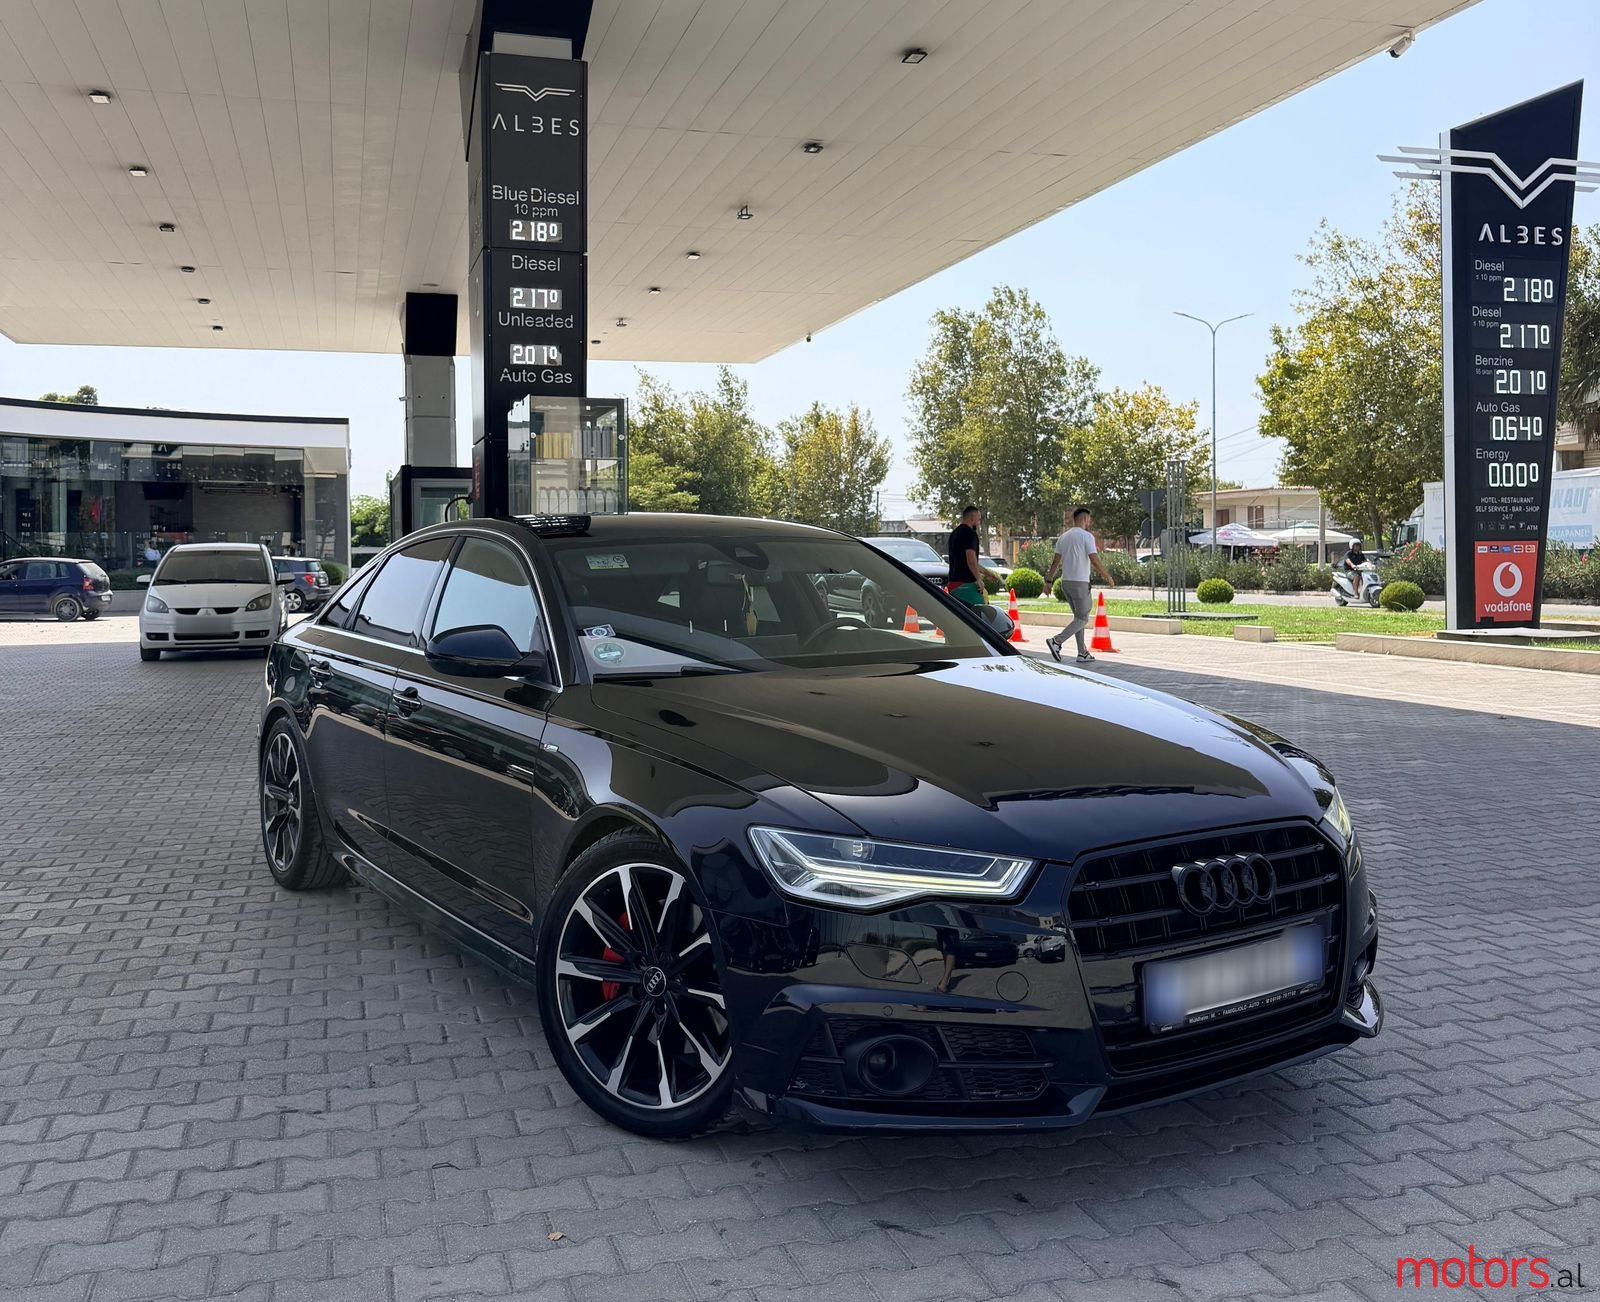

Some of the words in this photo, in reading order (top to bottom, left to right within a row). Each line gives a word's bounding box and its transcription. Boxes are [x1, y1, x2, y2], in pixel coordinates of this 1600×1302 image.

[492, 184, 528, 201] Blue
[530, 187, 580, 205] Diesel
[514, 203, 528, 215] 10
[532, 206, 558, 218] ppm
[511, 255, 561, 272] Diesel
[1474, 259, 1505, 272] Diesel
[1472, 305, 1502, 318] Diesel
[498, 312, 574, 329] Unleaded
[1475, 354, 1514, 367] Benzine
[500, 368, 537, 383] Auto
[541, 369, 573, 384] Gas
[1475, 401, 1498, 413] Auto
[1500, 402, 1521, 413] Gas
[1475, 448, 1510, 461] Energy
[1480, 496, 1498, 504] HOTEL
[1500, 496, 1534, 504] RESTAURANT
[1475, 505, 1487, 513] SELF
[1488, 505, 1509, 513] SERVICE
[1511, 505, 1523, 513] BAR
[1525, 505, 1540, 513] SHOP
[1501, 513, 1514, 521] 24/7
[1484, 600, 1532, 613] vodafone
